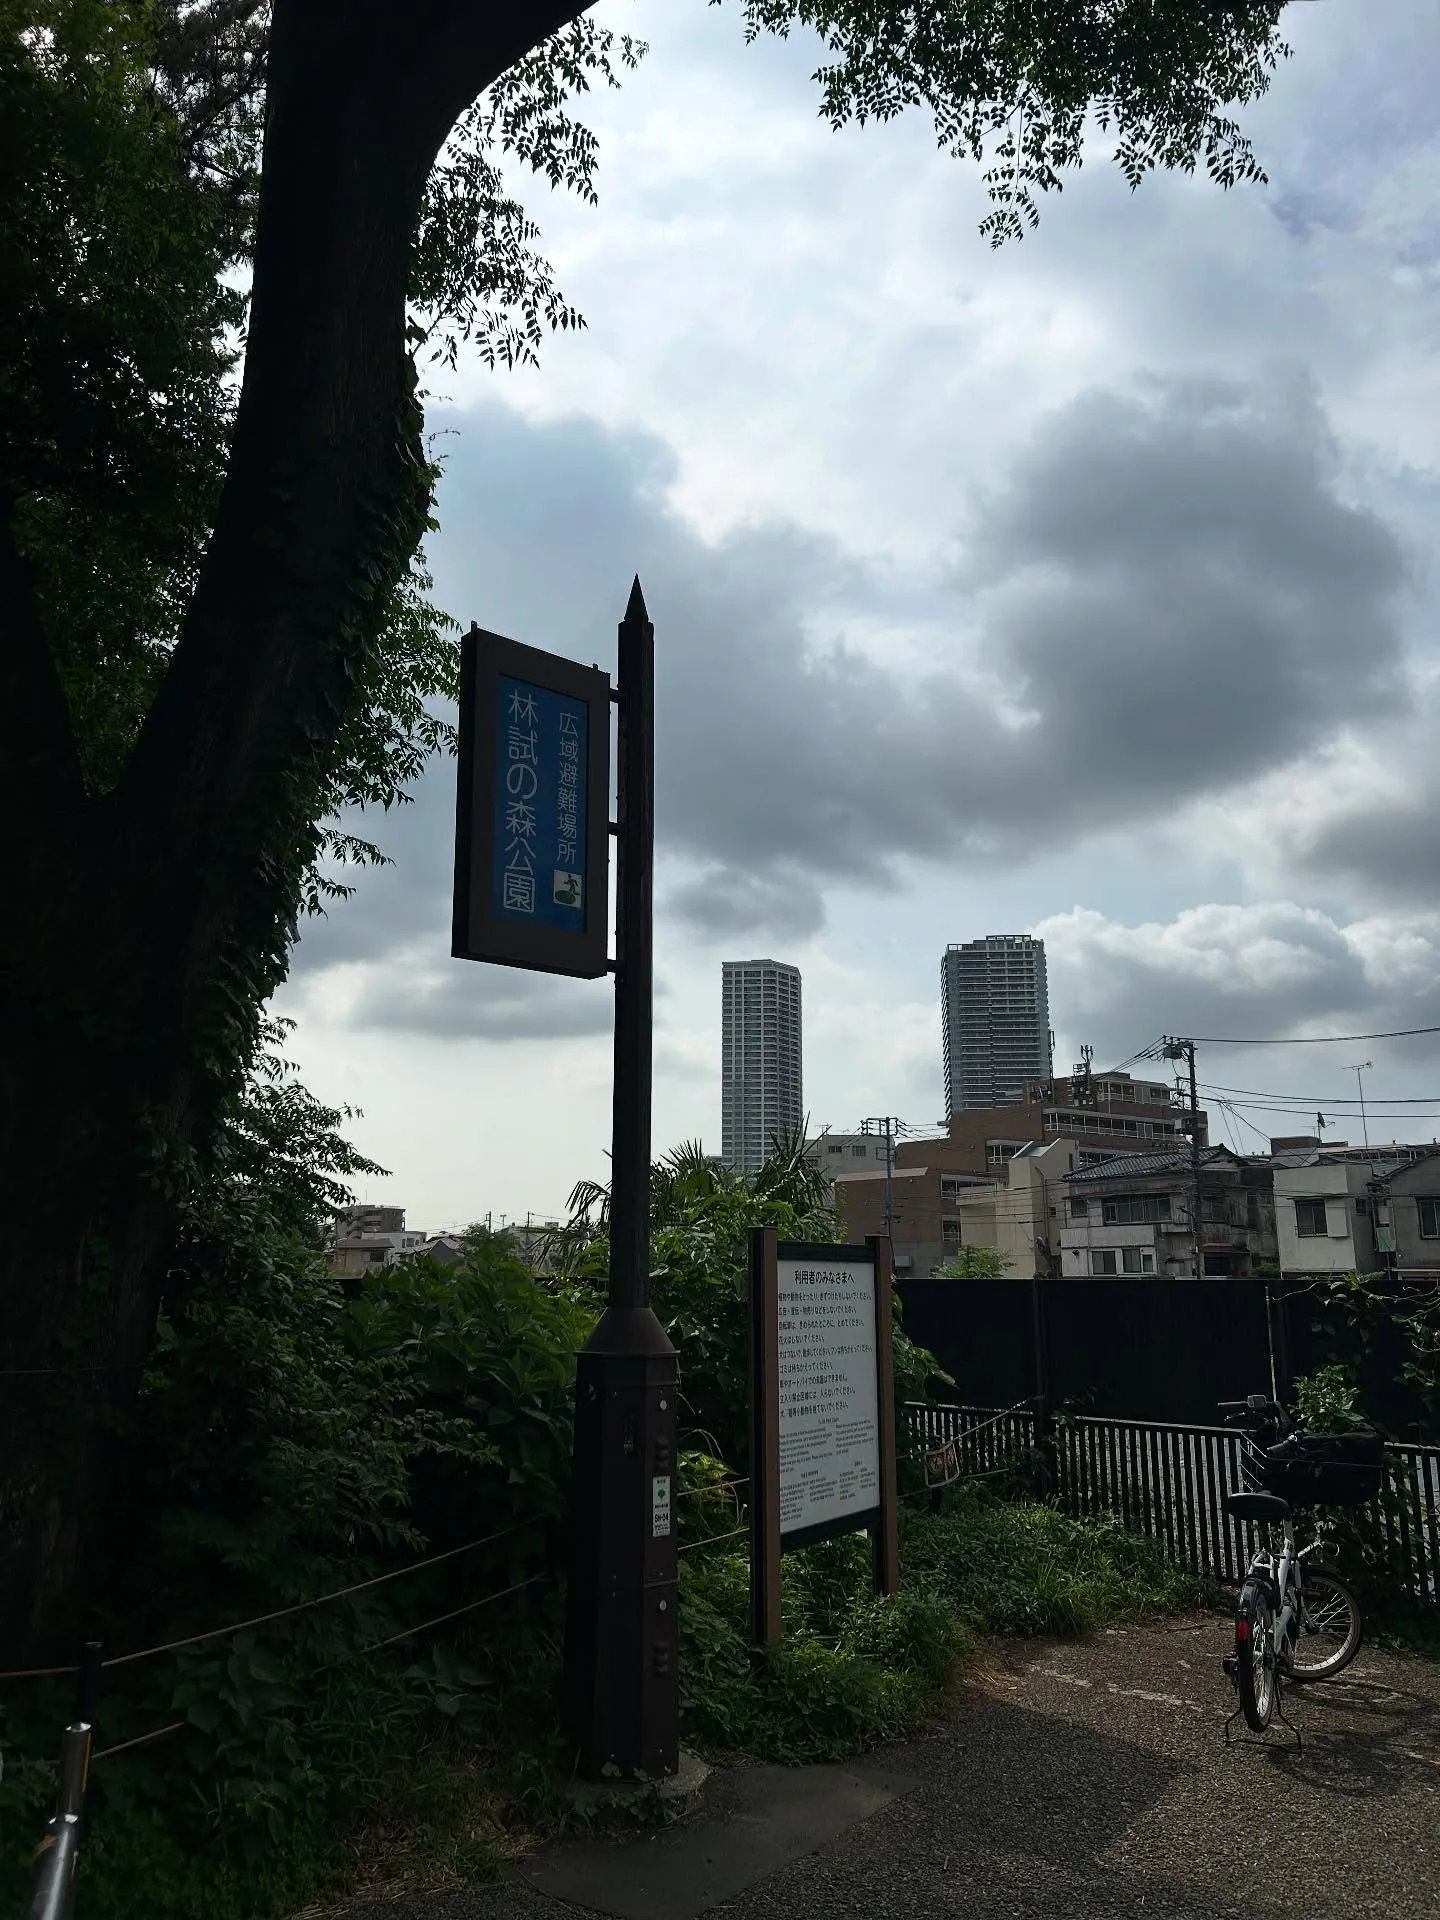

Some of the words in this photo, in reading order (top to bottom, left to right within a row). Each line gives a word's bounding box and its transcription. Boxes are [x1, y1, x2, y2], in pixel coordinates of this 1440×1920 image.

[503, 689, 539, 913] 林試の森公園
[556, 711, 580, 864] 広域避難場所
[795, 1270, 855, 1284] 利用者のみなさまへ
